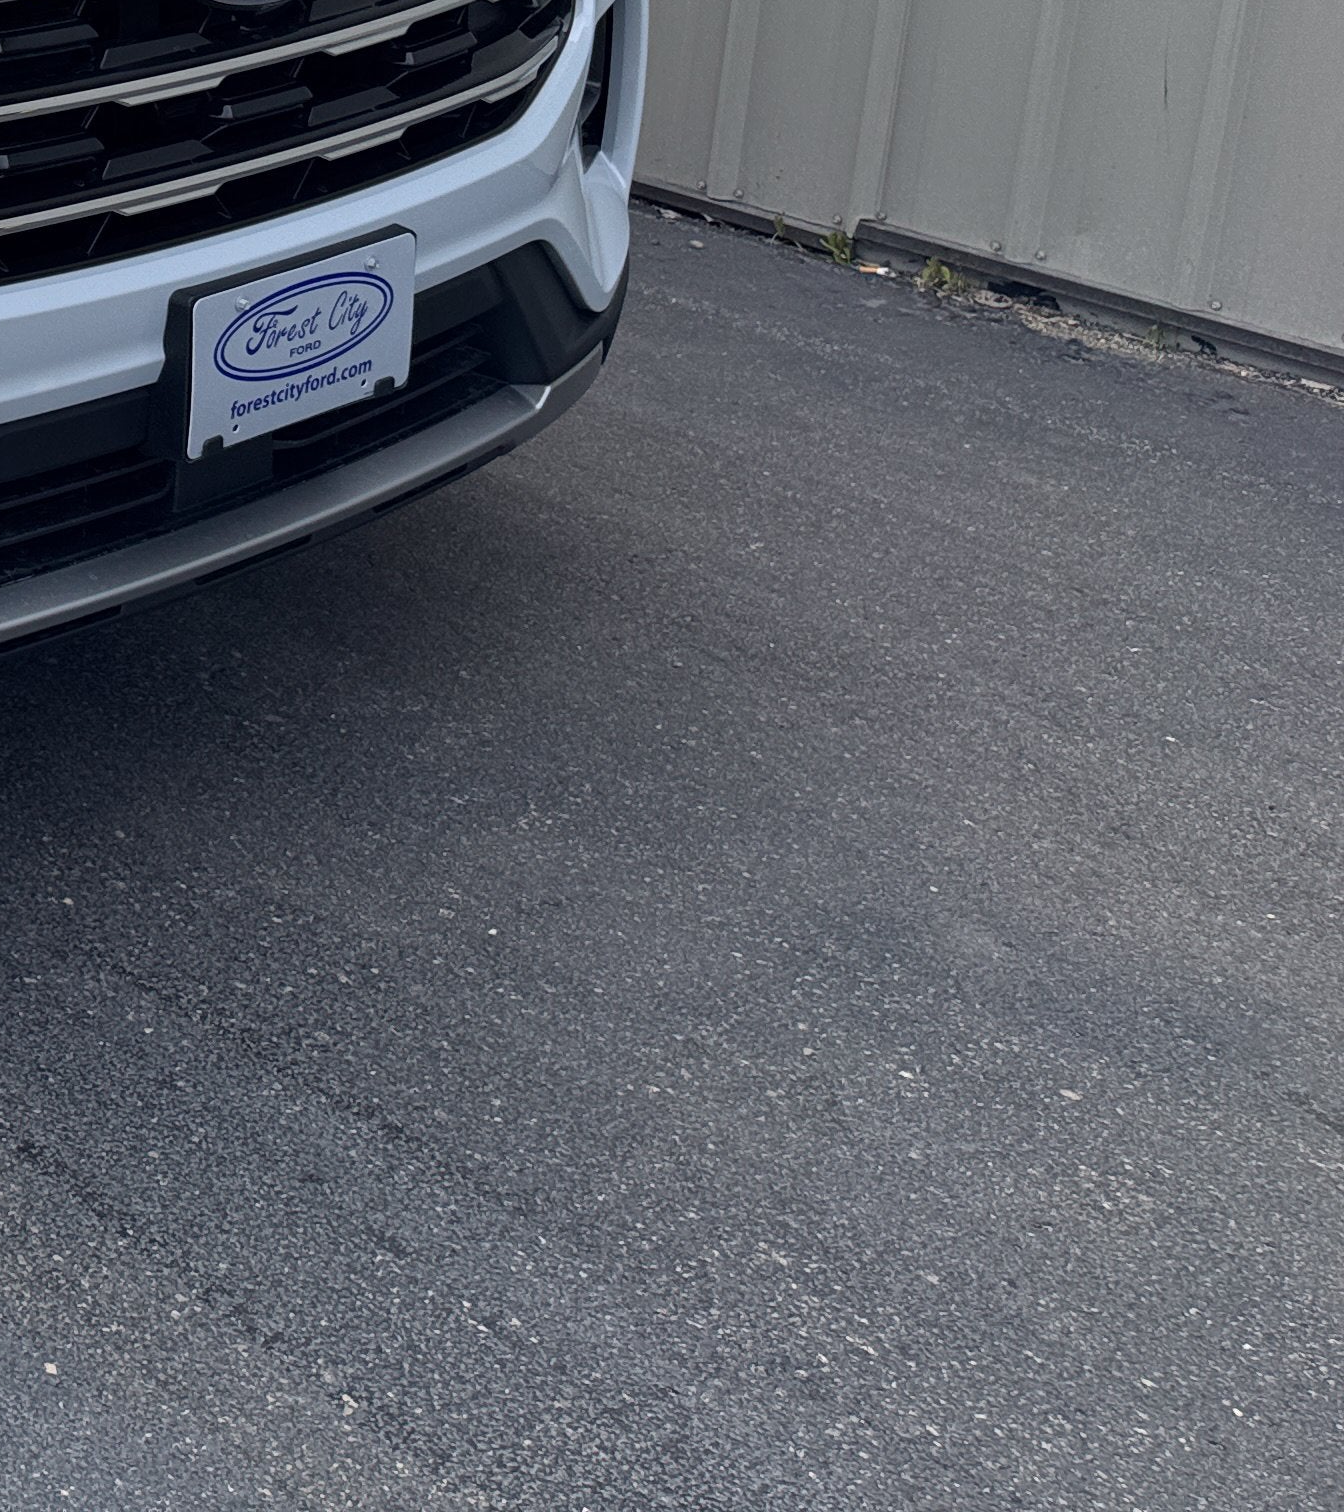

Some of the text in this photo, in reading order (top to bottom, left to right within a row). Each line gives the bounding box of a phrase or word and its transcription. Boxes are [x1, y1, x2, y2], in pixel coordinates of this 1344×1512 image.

[246, 290, 368, 355] Forest City
[289, 340, 321, 357] FORD
[230, 358, 372, 419] forestcityford.com
